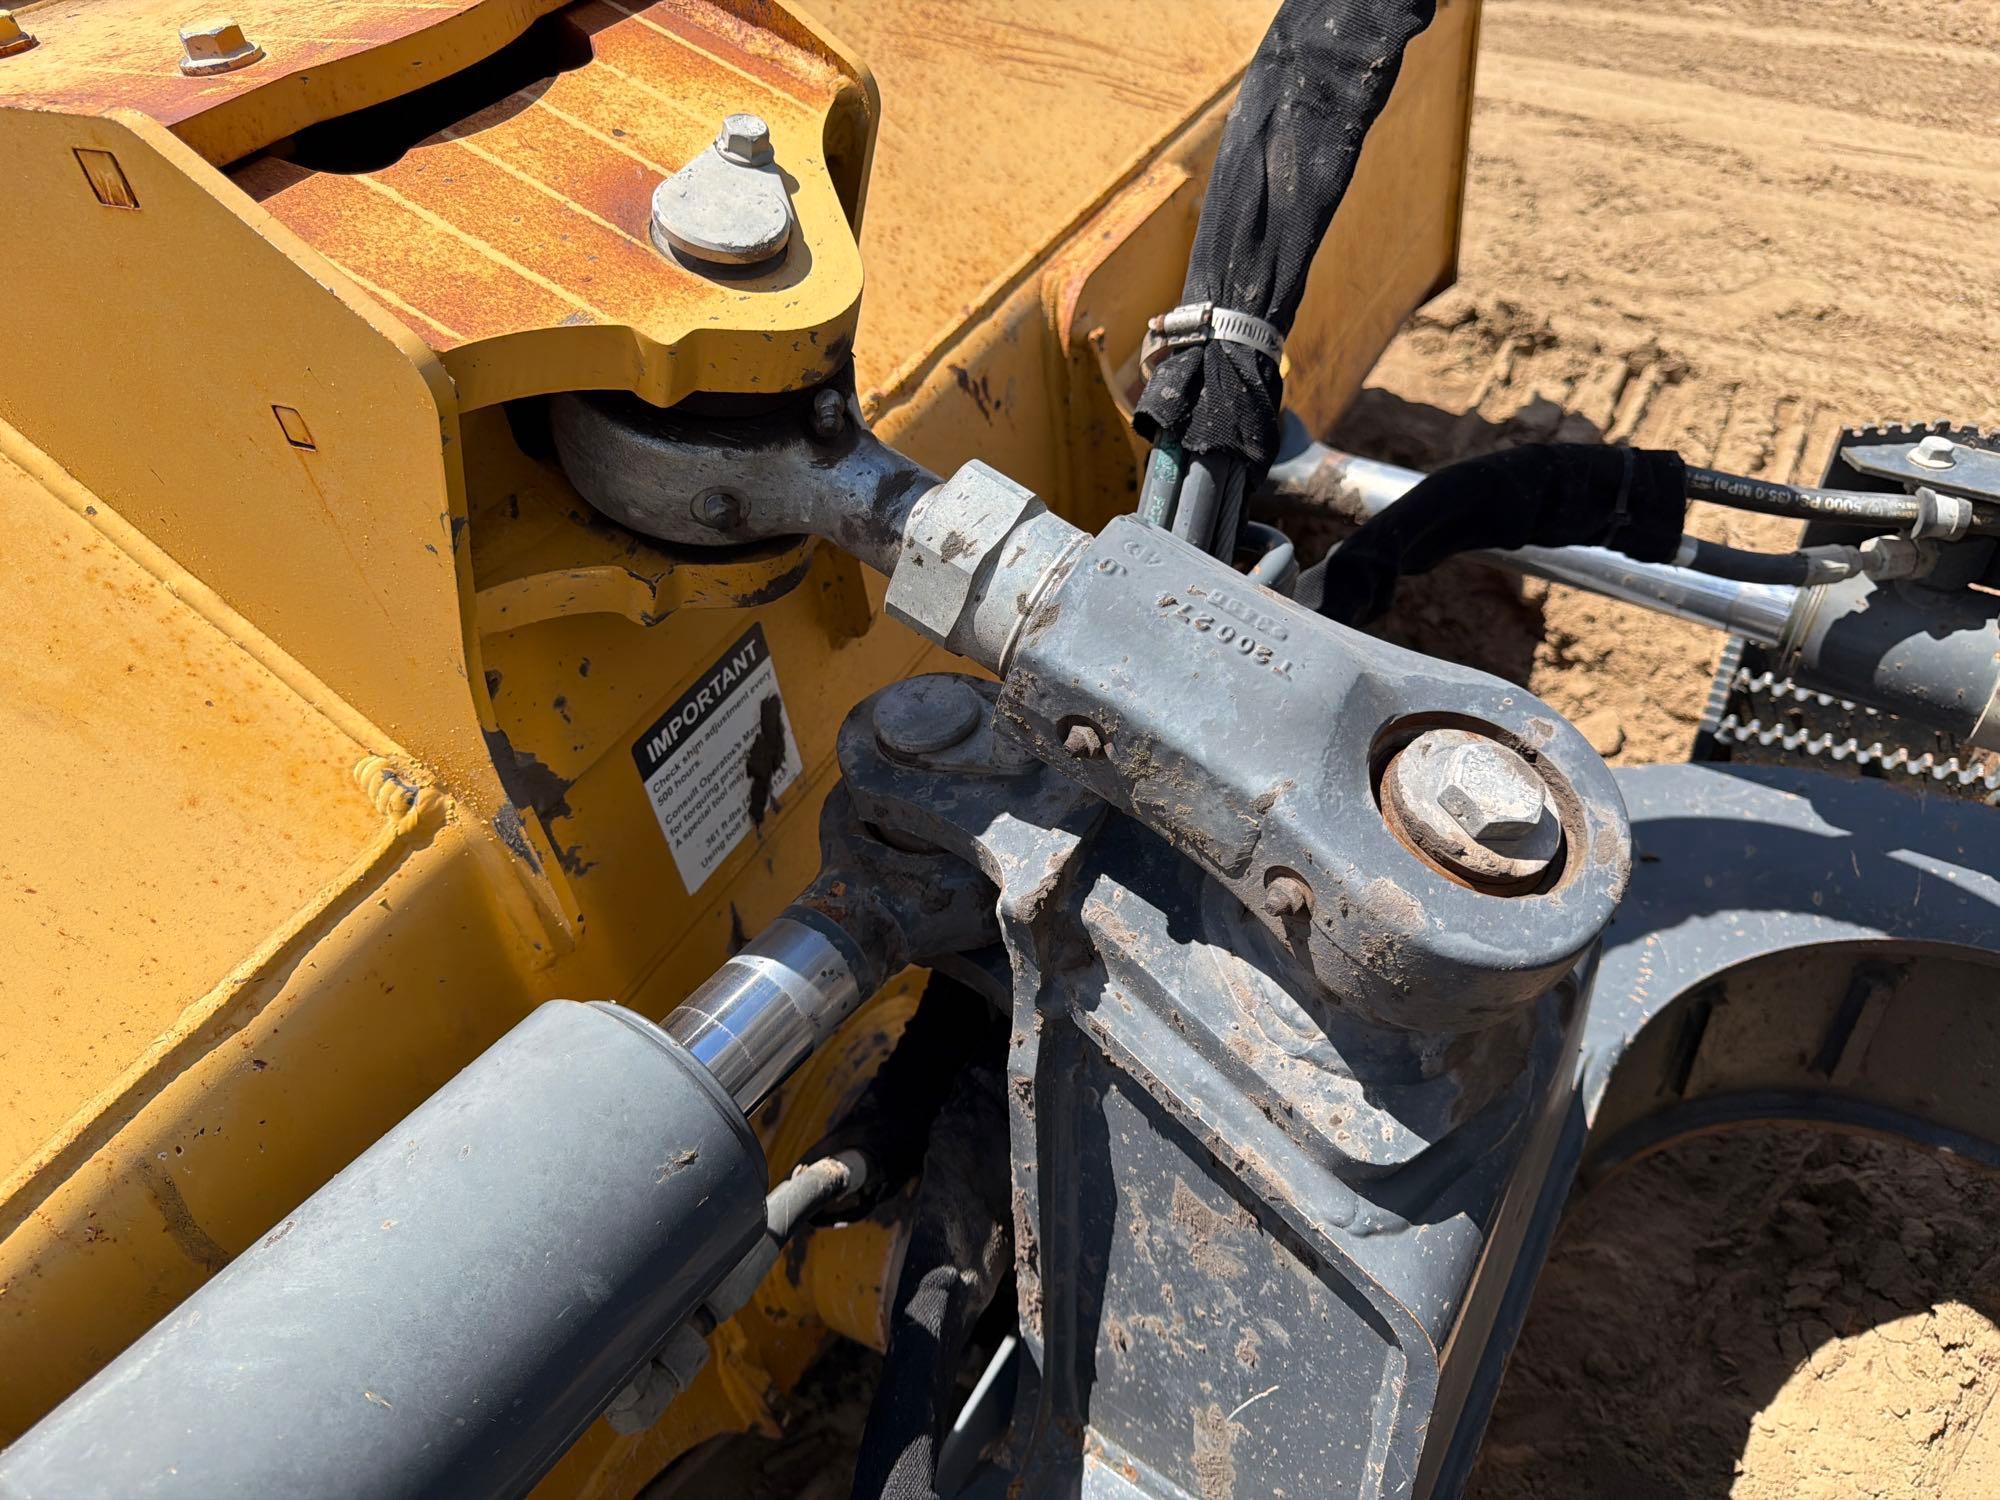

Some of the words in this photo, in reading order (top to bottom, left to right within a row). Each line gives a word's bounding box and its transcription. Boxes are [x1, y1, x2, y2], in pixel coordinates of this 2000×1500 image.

[1714, 477, 1753, 498] MPa)
[1755, 486, 1791, 505] (35.0
[1824, 495, 1862, 513] 5000
[646, 640, 758, 764] IMPORTANT
[653, 762, 681, 793] Check
[683, 739, 704, 763] shim
[705, 691, 749, 741] adjustment
[751, 669, 771, 694] every
[658, 787, 674, 805] 500
[676, 757, 703, 787] hours.
[666, 787, 699, 824] Consult
[700, 741, 742, 788] Operator's
[744, 720, 761, 741] Man
[671, 821, 683, 836] for
[684, 782, 719, 822] torquing
[675, 838, 682, 848] A
[684, 806, 712, 840] special
[714, 789, 728, 807] tool
[730, 771, 745, 790] may
[707, 829, 720, 847] 361
[722, 805, 742, 830] ft-lbs
[702, 840, 725, 868] Using
[727, 821, 742, 840] bolt
